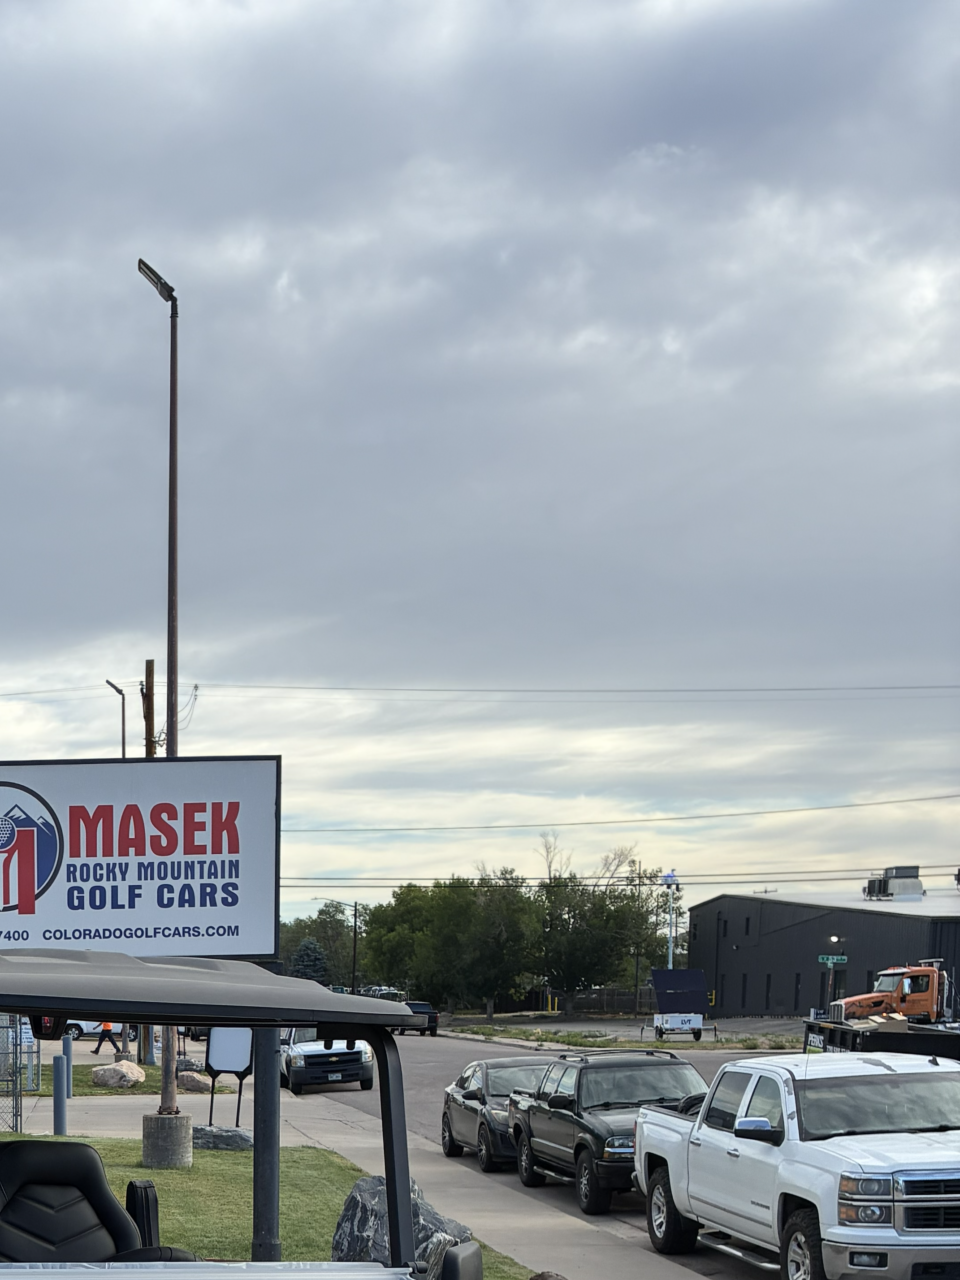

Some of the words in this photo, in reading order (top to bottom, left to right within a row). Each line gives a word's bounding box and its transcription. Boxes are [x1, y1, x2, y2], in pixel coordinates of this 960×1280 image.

[68, 801, 240, 858] MASEK
[66, 861, 129, 883] ROCKY
[137, 858, 240, 882] MOUNTAIN
[66, 883, 142, 910] GOLF
[156, 882, 240, 908] CARS
[42, 924, 240, 940] COLORADOGOLFCARS.COM
